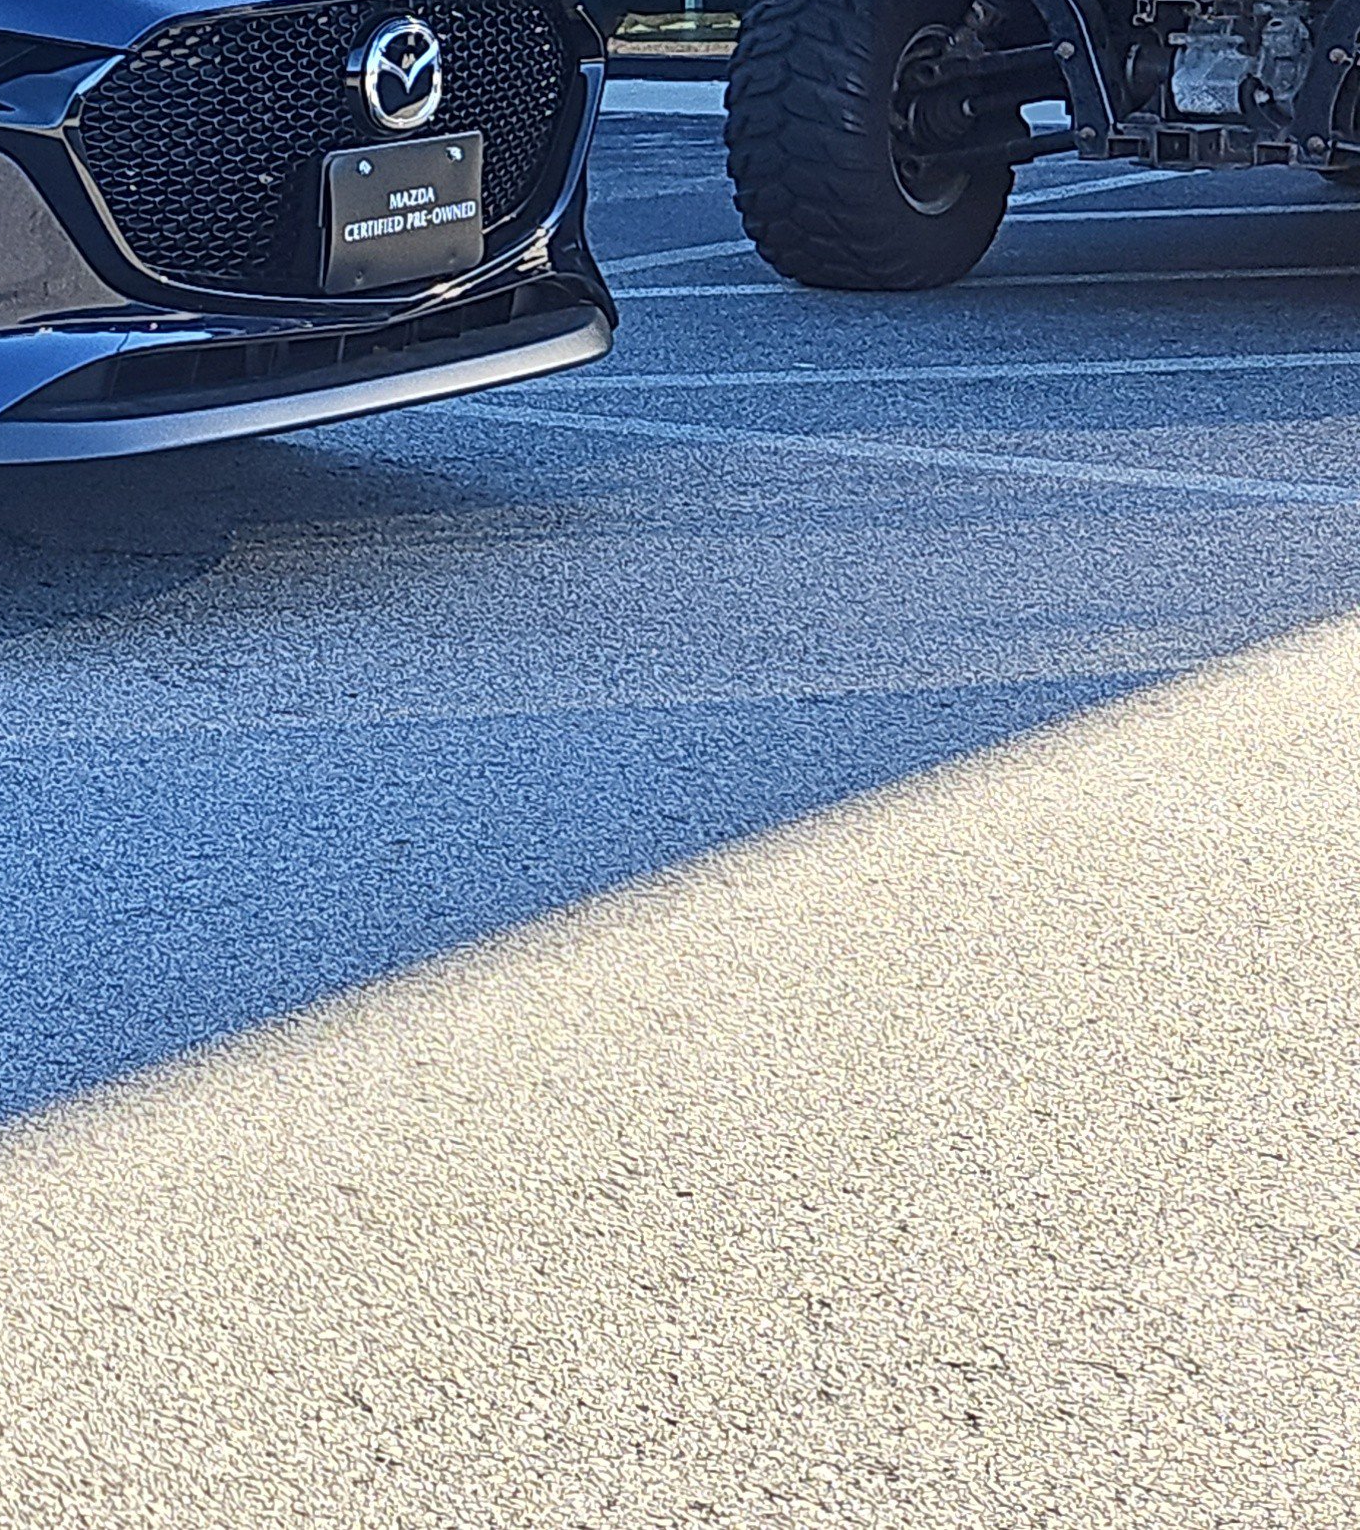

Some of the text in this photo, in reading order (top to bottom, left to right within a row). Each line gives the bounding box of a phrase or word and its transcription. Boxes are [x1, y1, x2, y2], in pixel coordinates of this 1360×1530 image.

[389, 186, 436, 210] MAZDA
[344, 200, 477, 242] CERTIFIED PRE-OWNED
